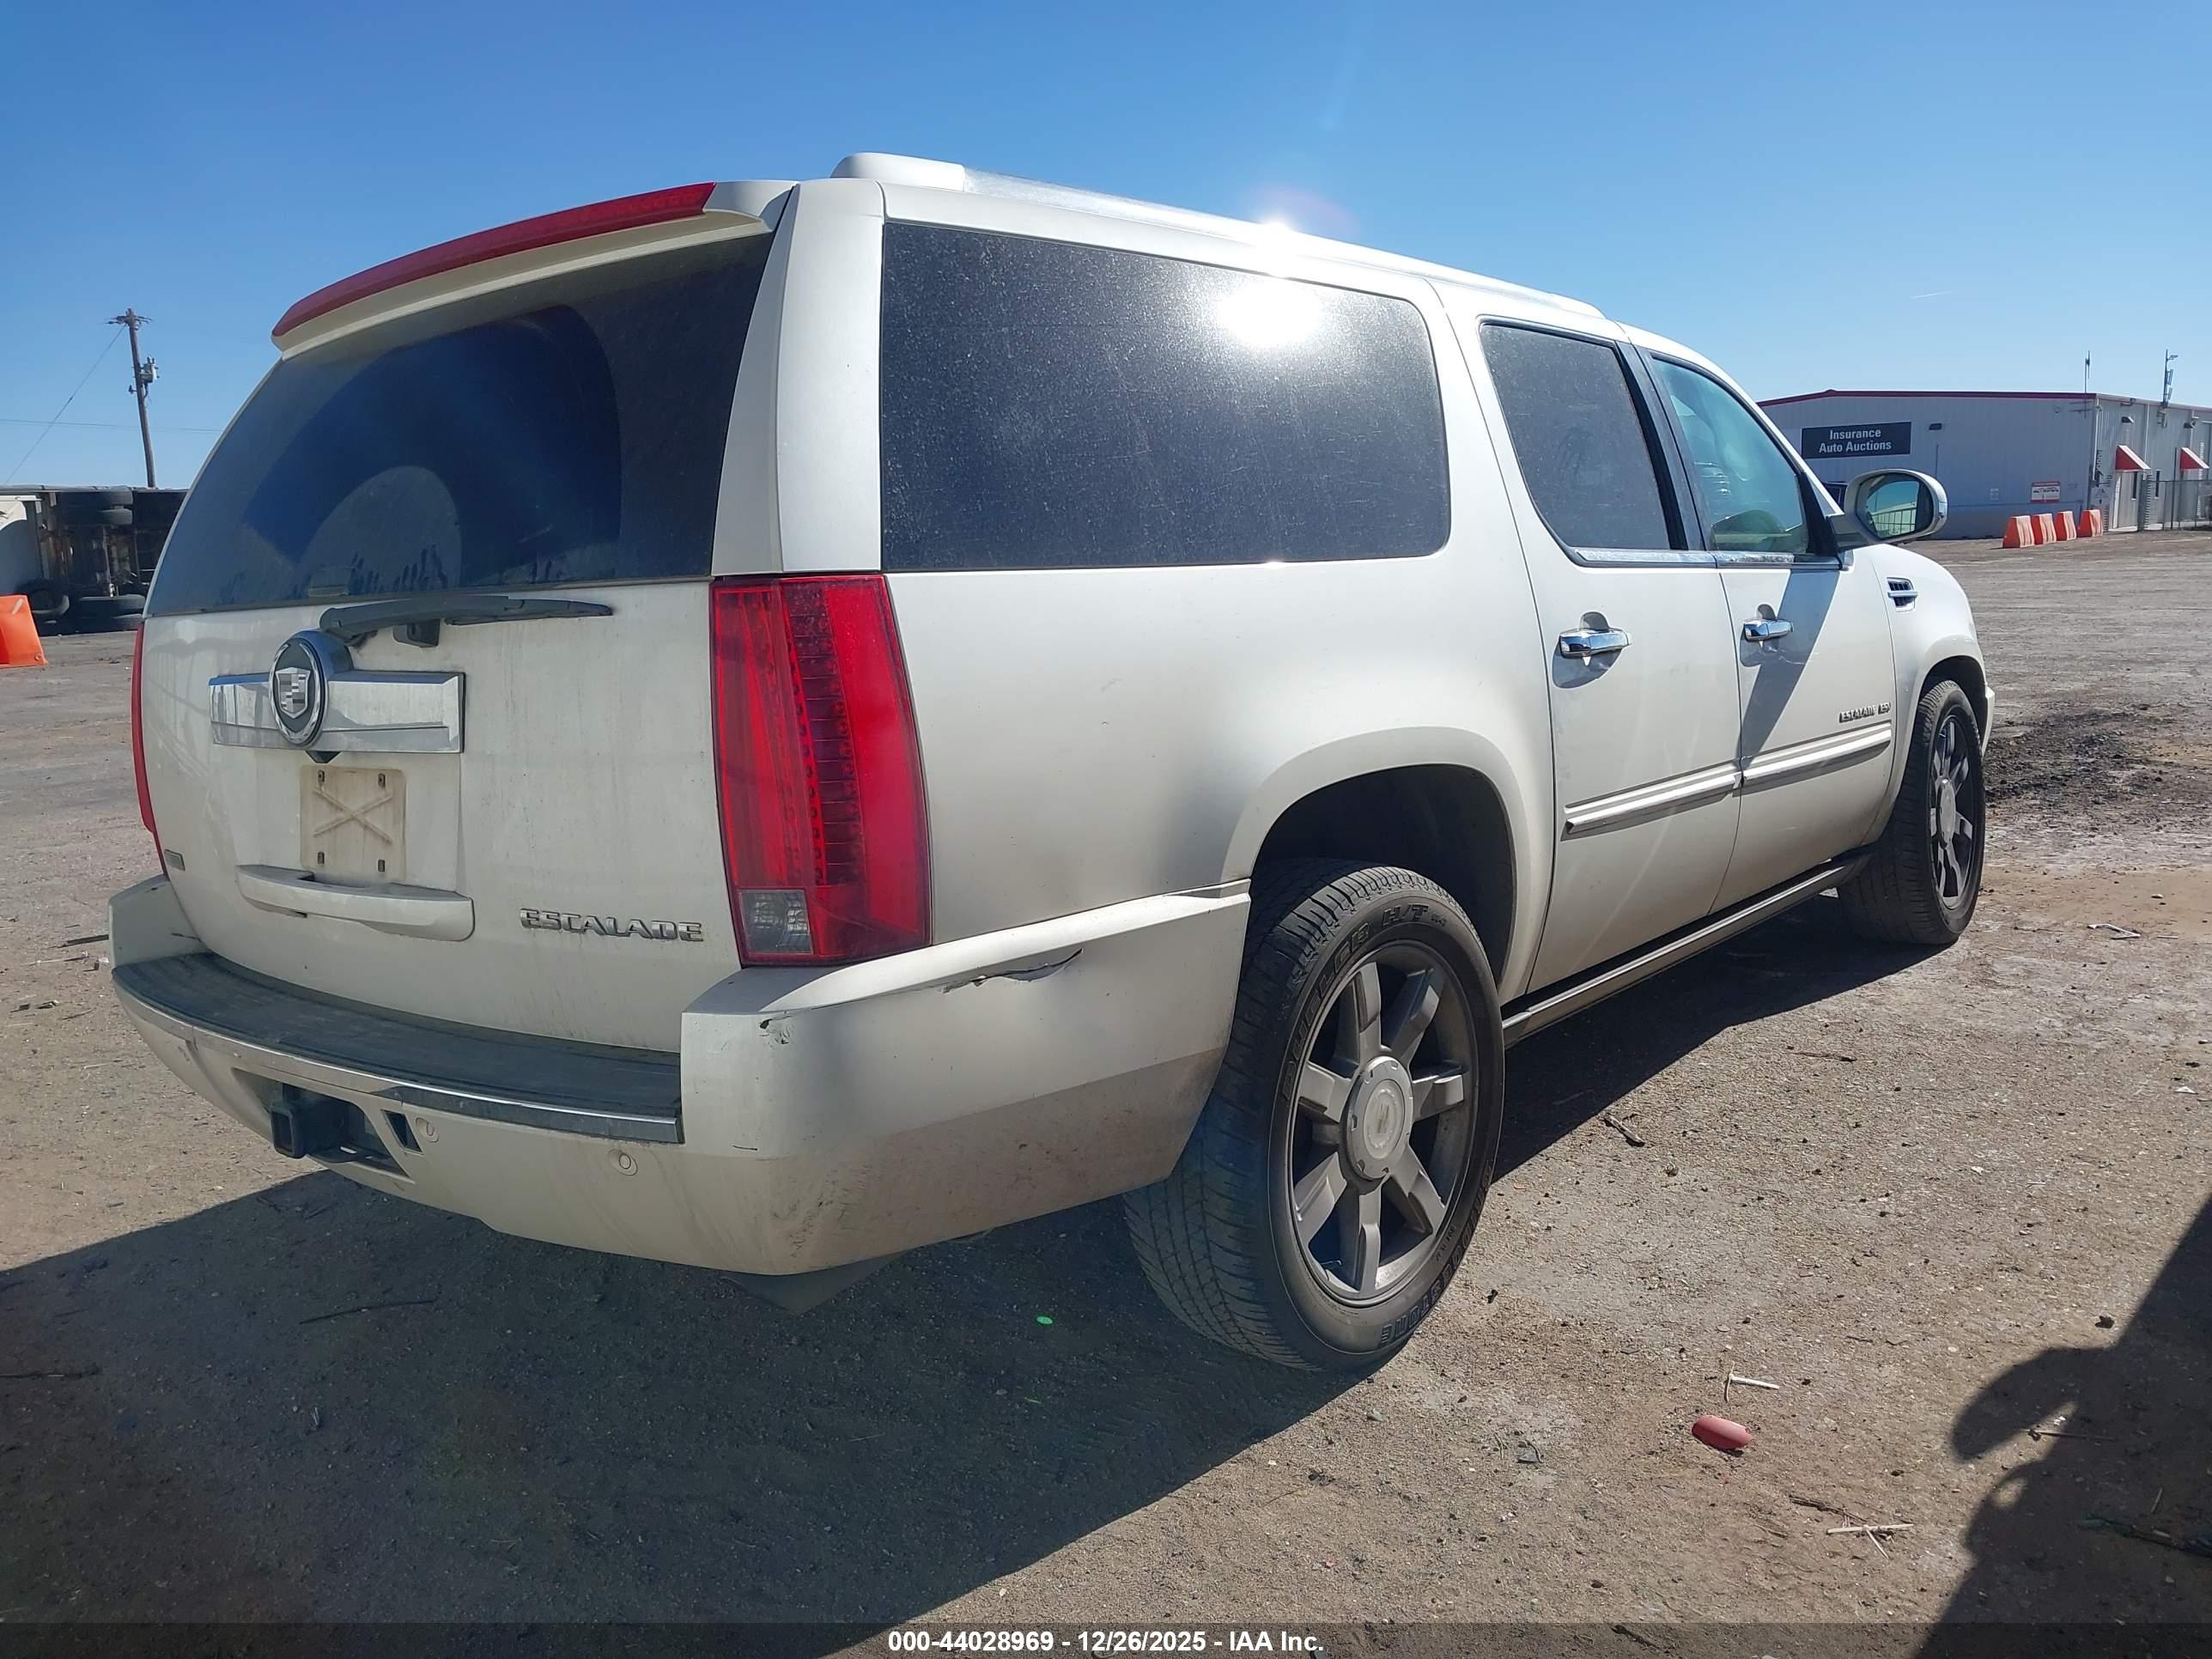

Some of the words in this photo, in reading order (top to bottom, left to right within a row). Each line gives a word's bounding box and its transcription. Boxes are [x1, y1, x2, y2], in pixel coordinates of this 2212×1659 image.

[1829, 428, 1882, 441] Insurance
[1819, 441, 1844, 453] Auto
[1845, 439, 1893, 452] Auctions
[520, 908, 704, 942] ESCALADE
[1382, 902, 1430, 928] H/T
